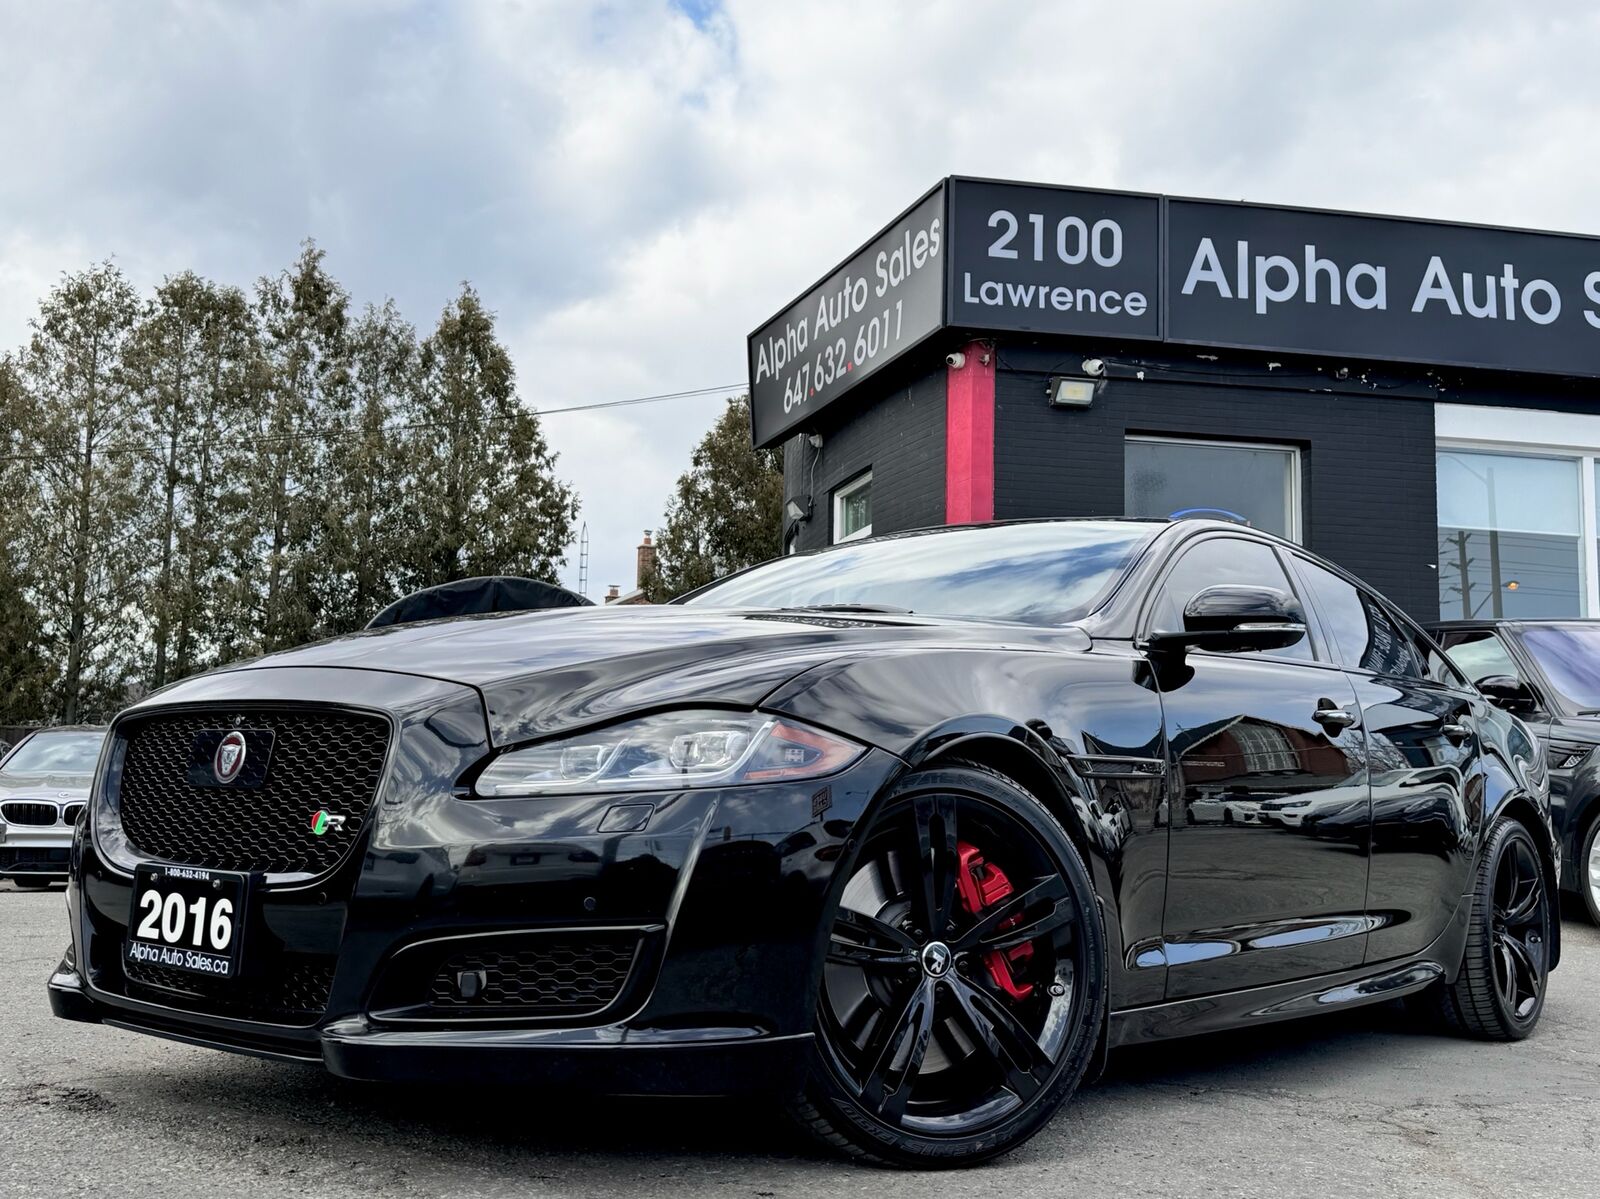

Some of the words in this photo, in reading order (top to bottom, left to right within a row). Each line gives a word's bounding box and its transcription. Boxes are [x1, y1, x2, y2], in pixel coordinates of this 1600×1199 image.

[987, 209, 1123, 268] 2100
[755, 316, 809, 385] Alpha
[813, 276, 869, 341] Auto
[875, 217, 941, 298] Sales
[964, 272, 1148, 317] Lawrence
[1181, 237, 1387, 315] Alpha
[1411, 255, 1562, 325] Auto
[783, 299, 903, 414] 647.632.6011
[136, 889, 234, 950] 2016
[129, 942, 160, 962] Alpha
[159, 944, 185, 966] Auto
[185, 951, 229, 975] Sales.ca
